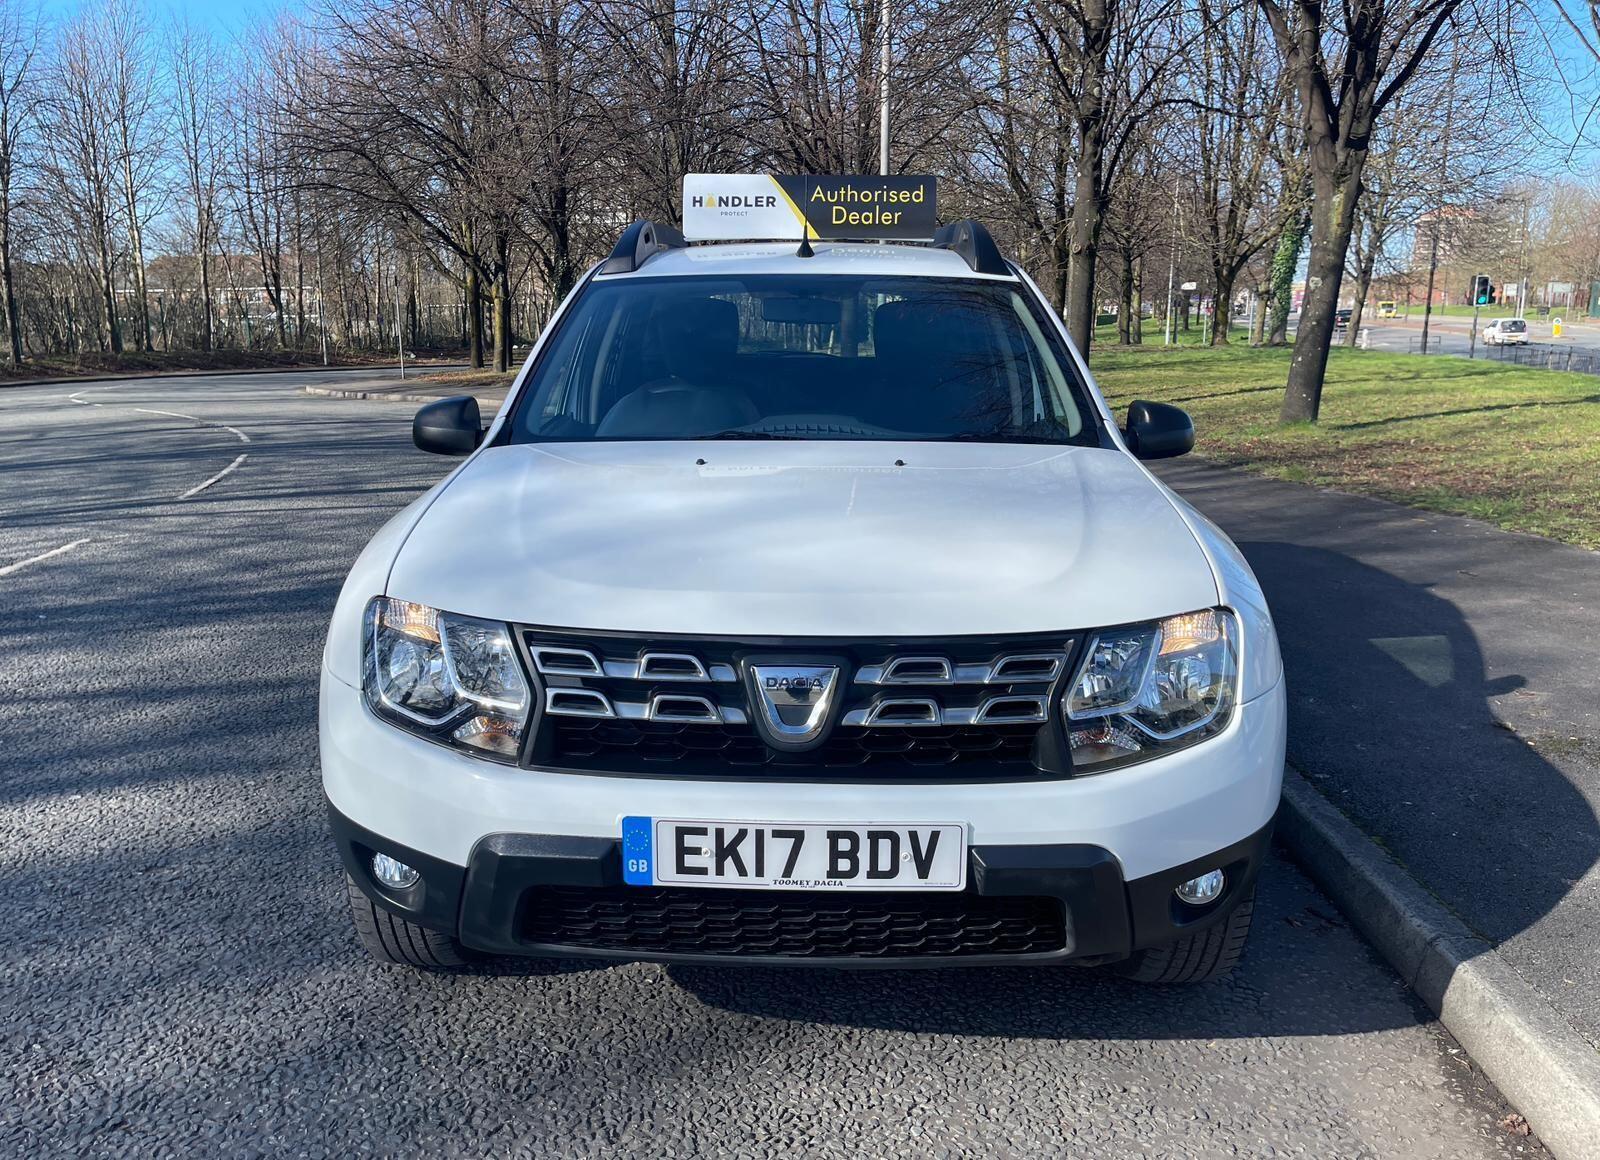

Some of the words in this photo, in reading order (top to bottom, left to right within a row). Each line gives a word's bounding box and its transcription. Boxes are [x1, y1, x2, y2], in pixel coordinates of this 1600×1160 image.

[810, 184, 924, 203] Authorised
[832, 205, 902, 225] Dealer
[766, 677, 824, 688] DACIA
[675, 826, 805, 878] EK17
[826, 830, 941, 880] BDV
[628, 859, 648, 872] GB
